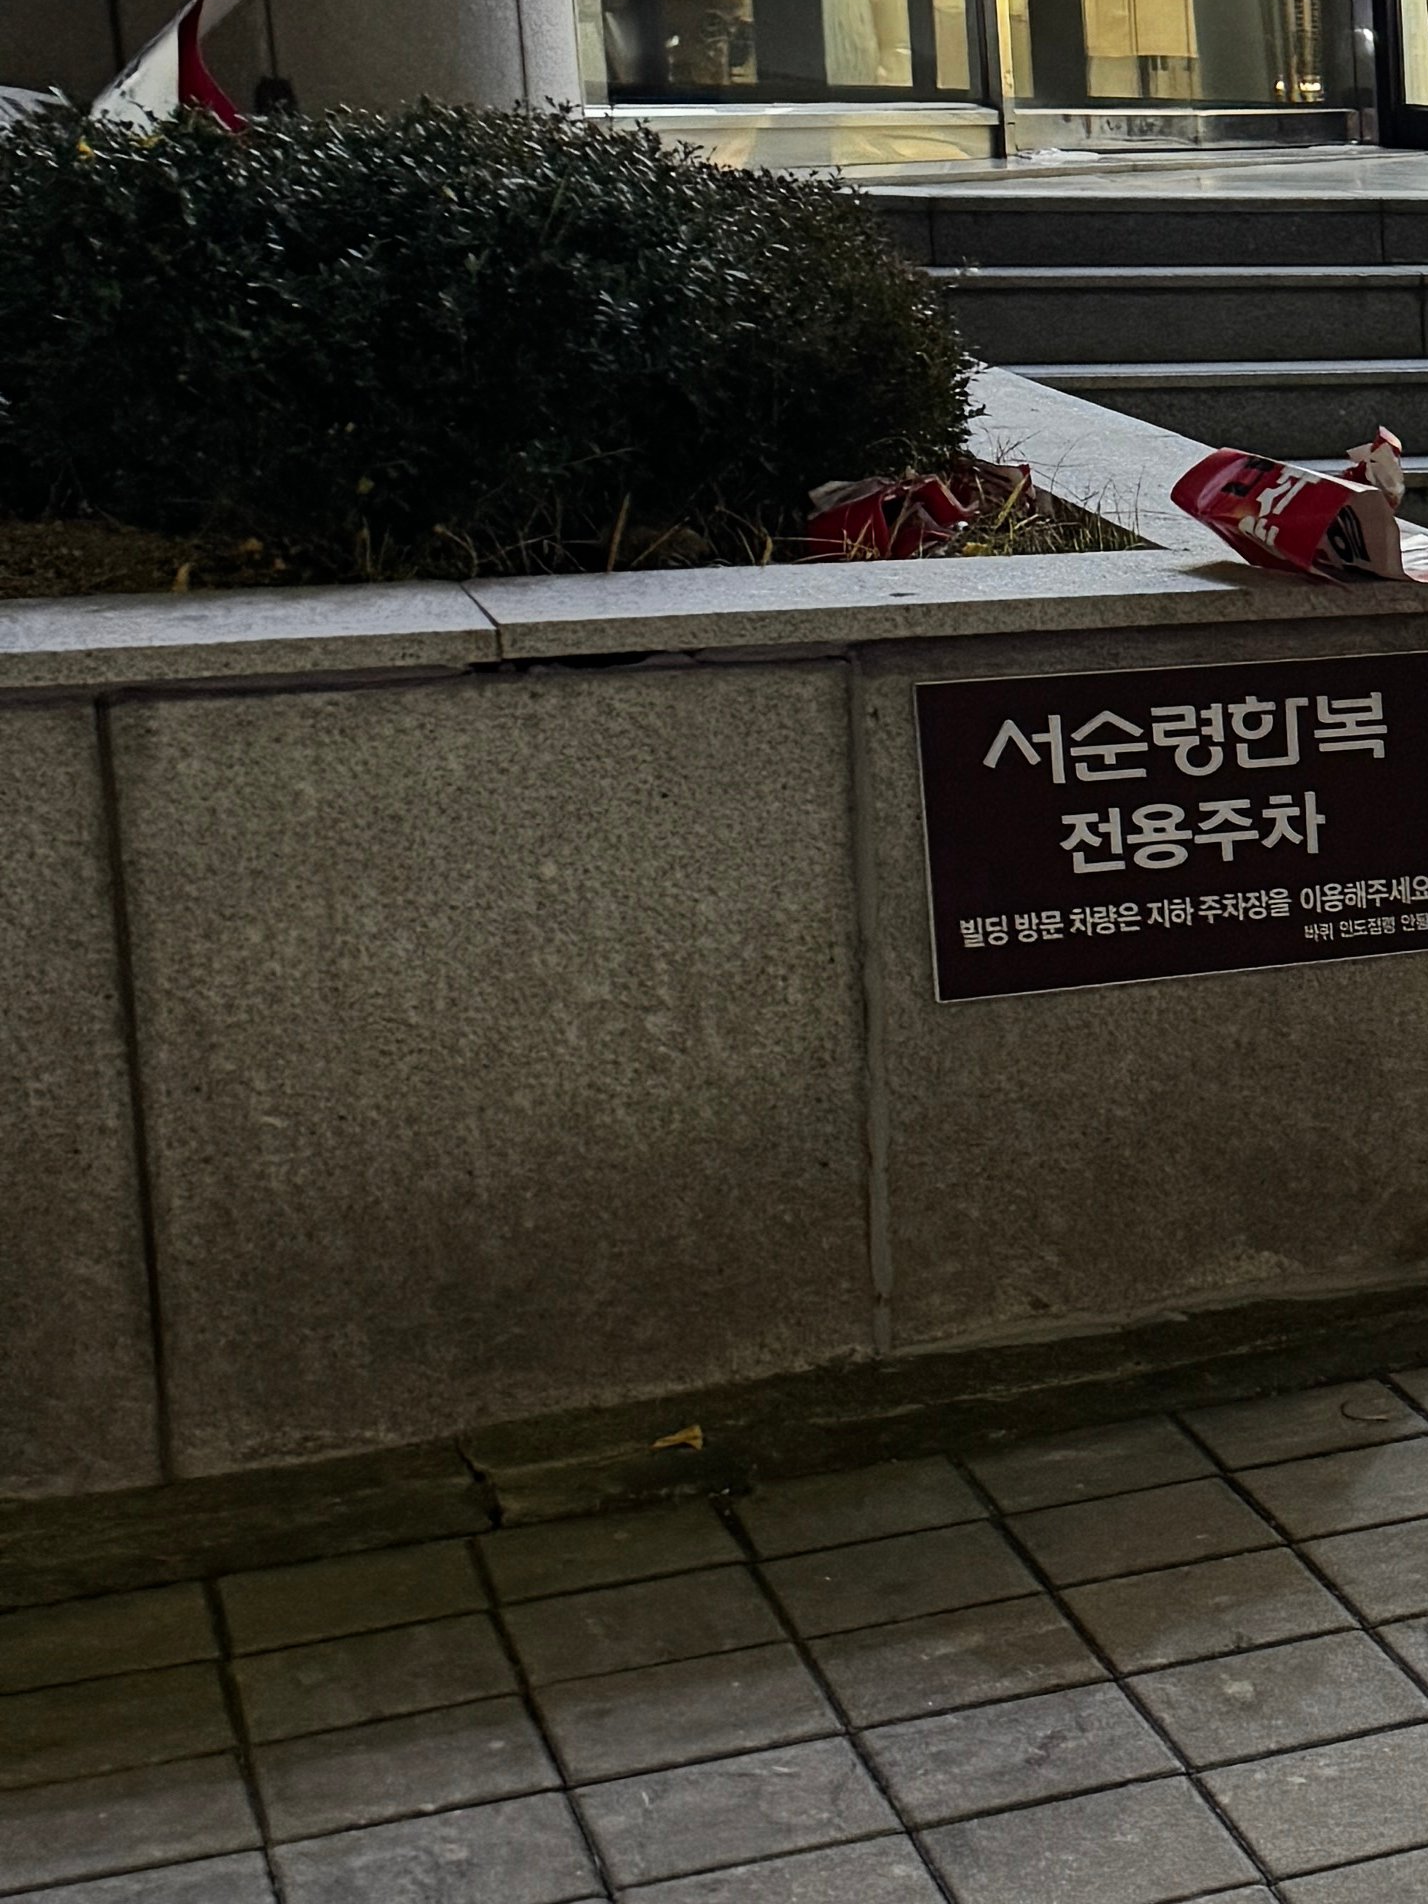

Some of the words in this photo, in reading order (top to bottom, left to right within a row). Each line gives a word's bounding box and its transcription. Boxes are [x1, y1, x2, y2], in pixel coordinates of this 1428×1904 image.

[983, 691, 1388, 784] 서순령한복
[1059, 790, 1326, 874] 전용주차
[960, 917, 1009, 949] 빌딩
[1014, 910, 1064, 942] 방문
[1068, 902, 1141, 938] 차량은
[1147, 896, 1195, 928] 지하
[1198, 887, 1291, 924] 주차장을
